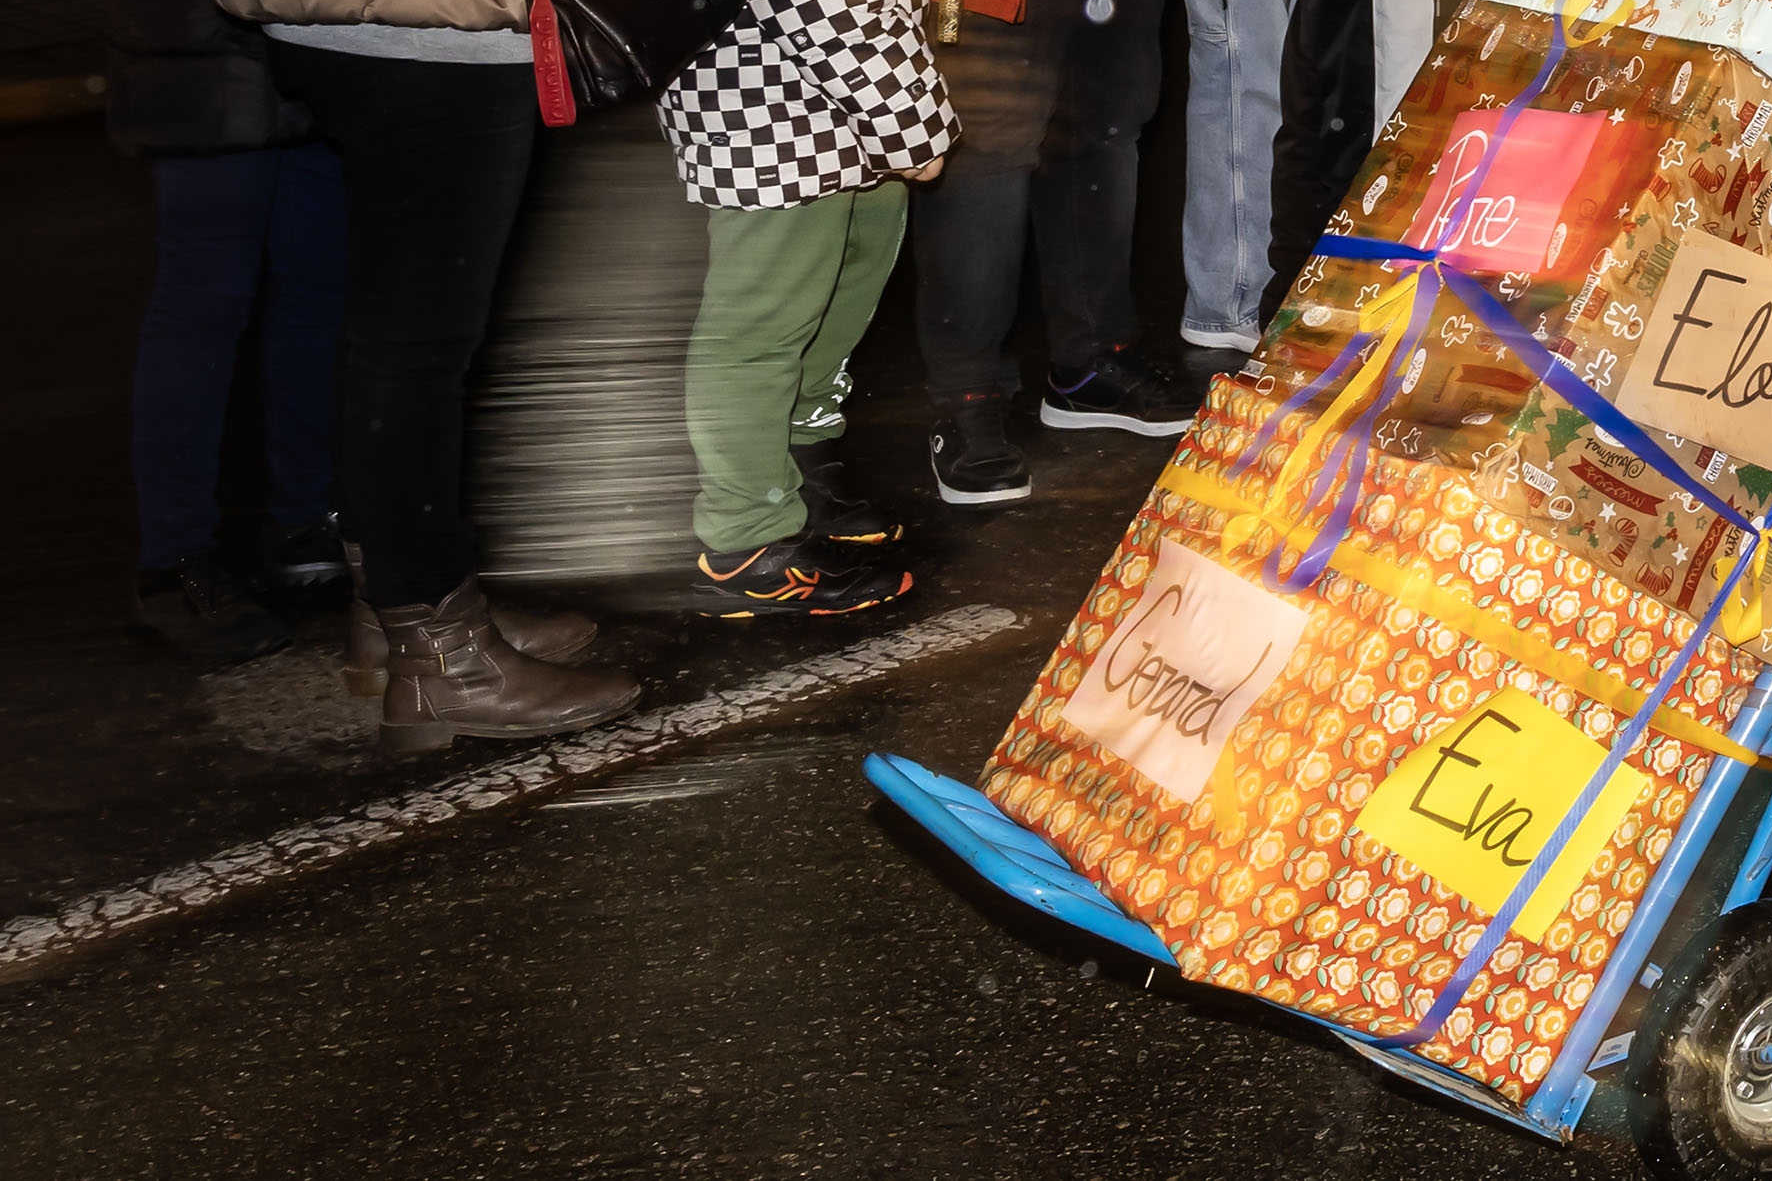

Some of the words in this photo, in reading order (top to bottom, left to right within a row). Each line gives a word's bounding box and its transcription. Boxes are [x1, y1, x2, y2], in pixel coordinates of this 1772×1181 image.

[1568, 275, 1598, 322] CHRISTMAS
[1585, 438, 1647, 480] Christmas
[1105, 584, 1273, 747] Gerard
[1409, 709, 1534, 867] Eva
